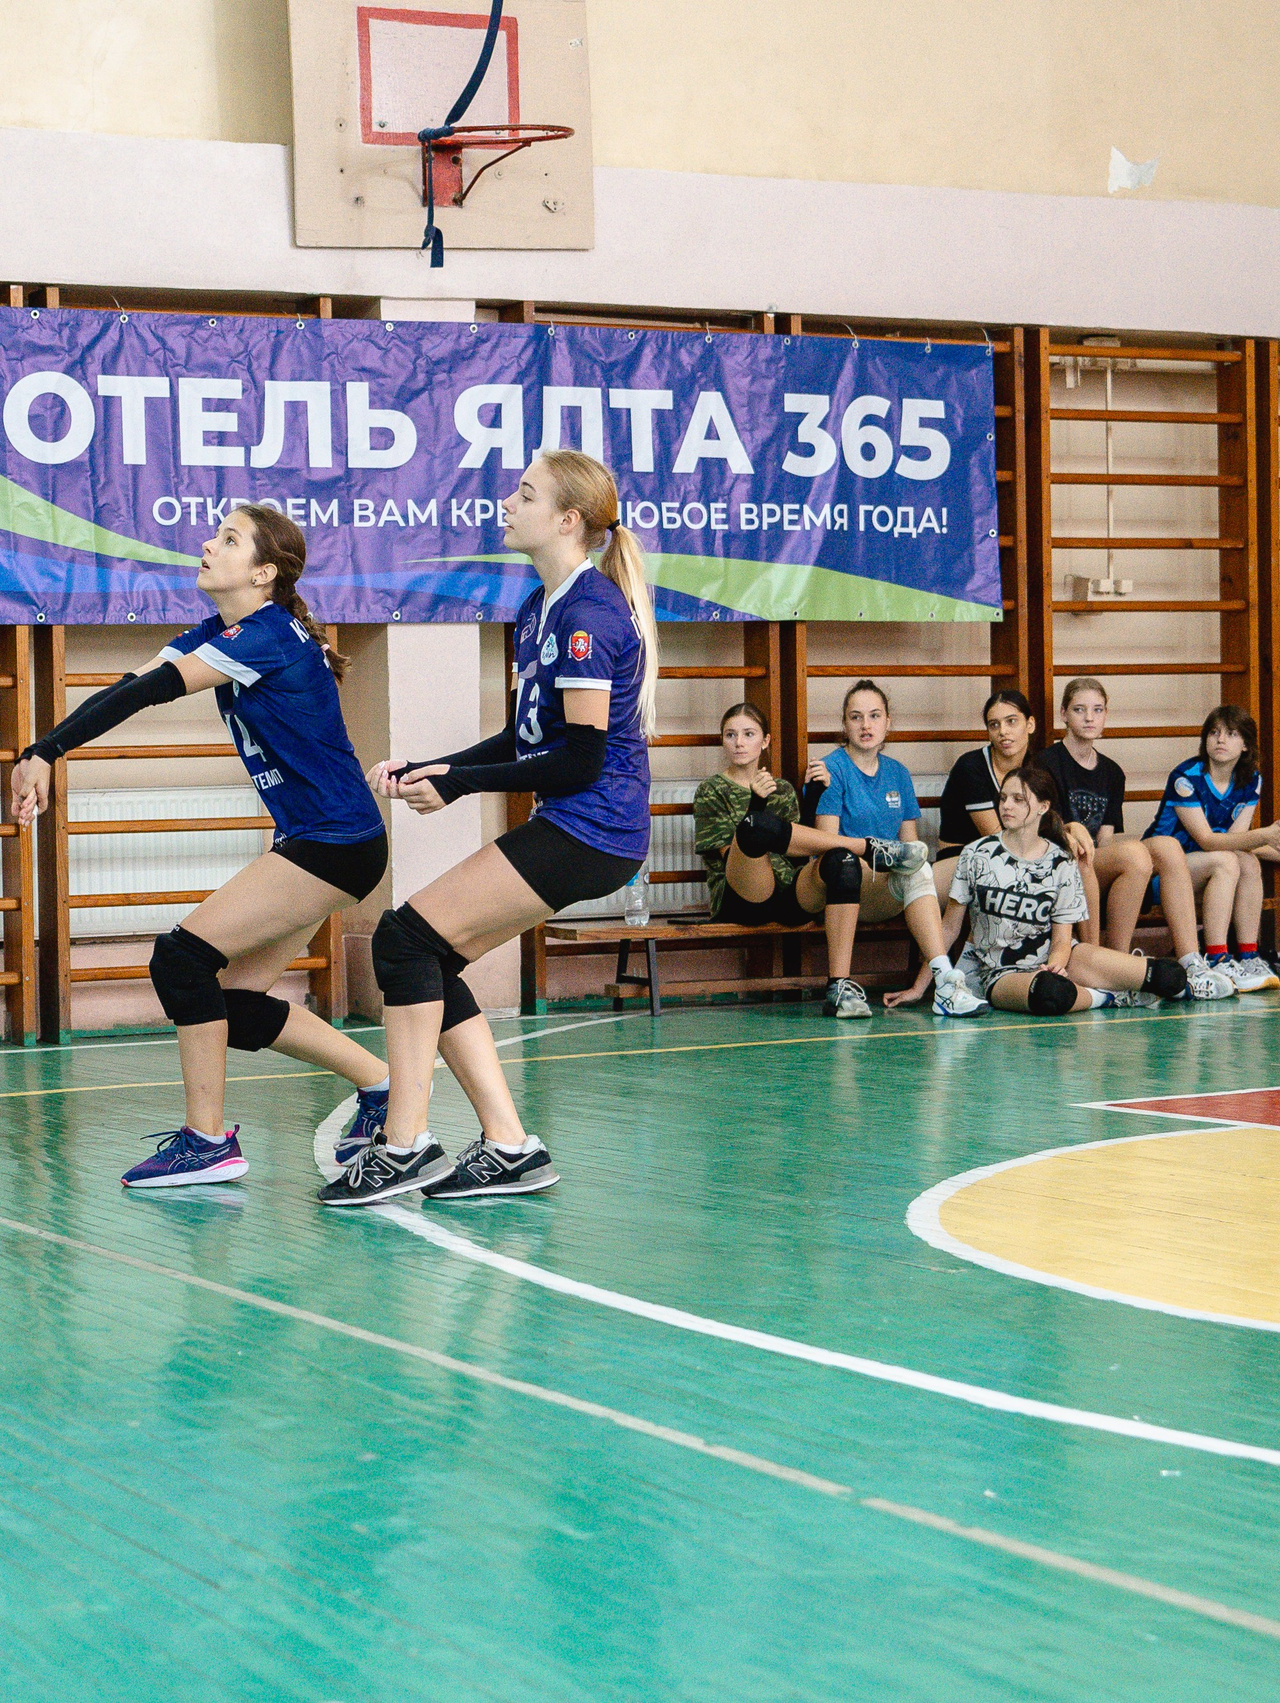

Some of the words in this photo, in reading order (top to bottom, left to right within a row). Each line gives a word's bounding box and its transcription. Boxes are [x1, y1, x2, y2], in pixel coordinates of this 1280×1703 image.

[2, 370, 418, 469] ОТЕЛЬ
[453, 384, 755, 475] ЯЛТА
[781, 393, 951, 481] 365
[353, 498, 437, 527] ВАМ
[739, 503, 848, 531] ВРЕМЯ
[858, 504, 948, 539] ГОДА!
[251, 768, 284, 790] ТЕМП
